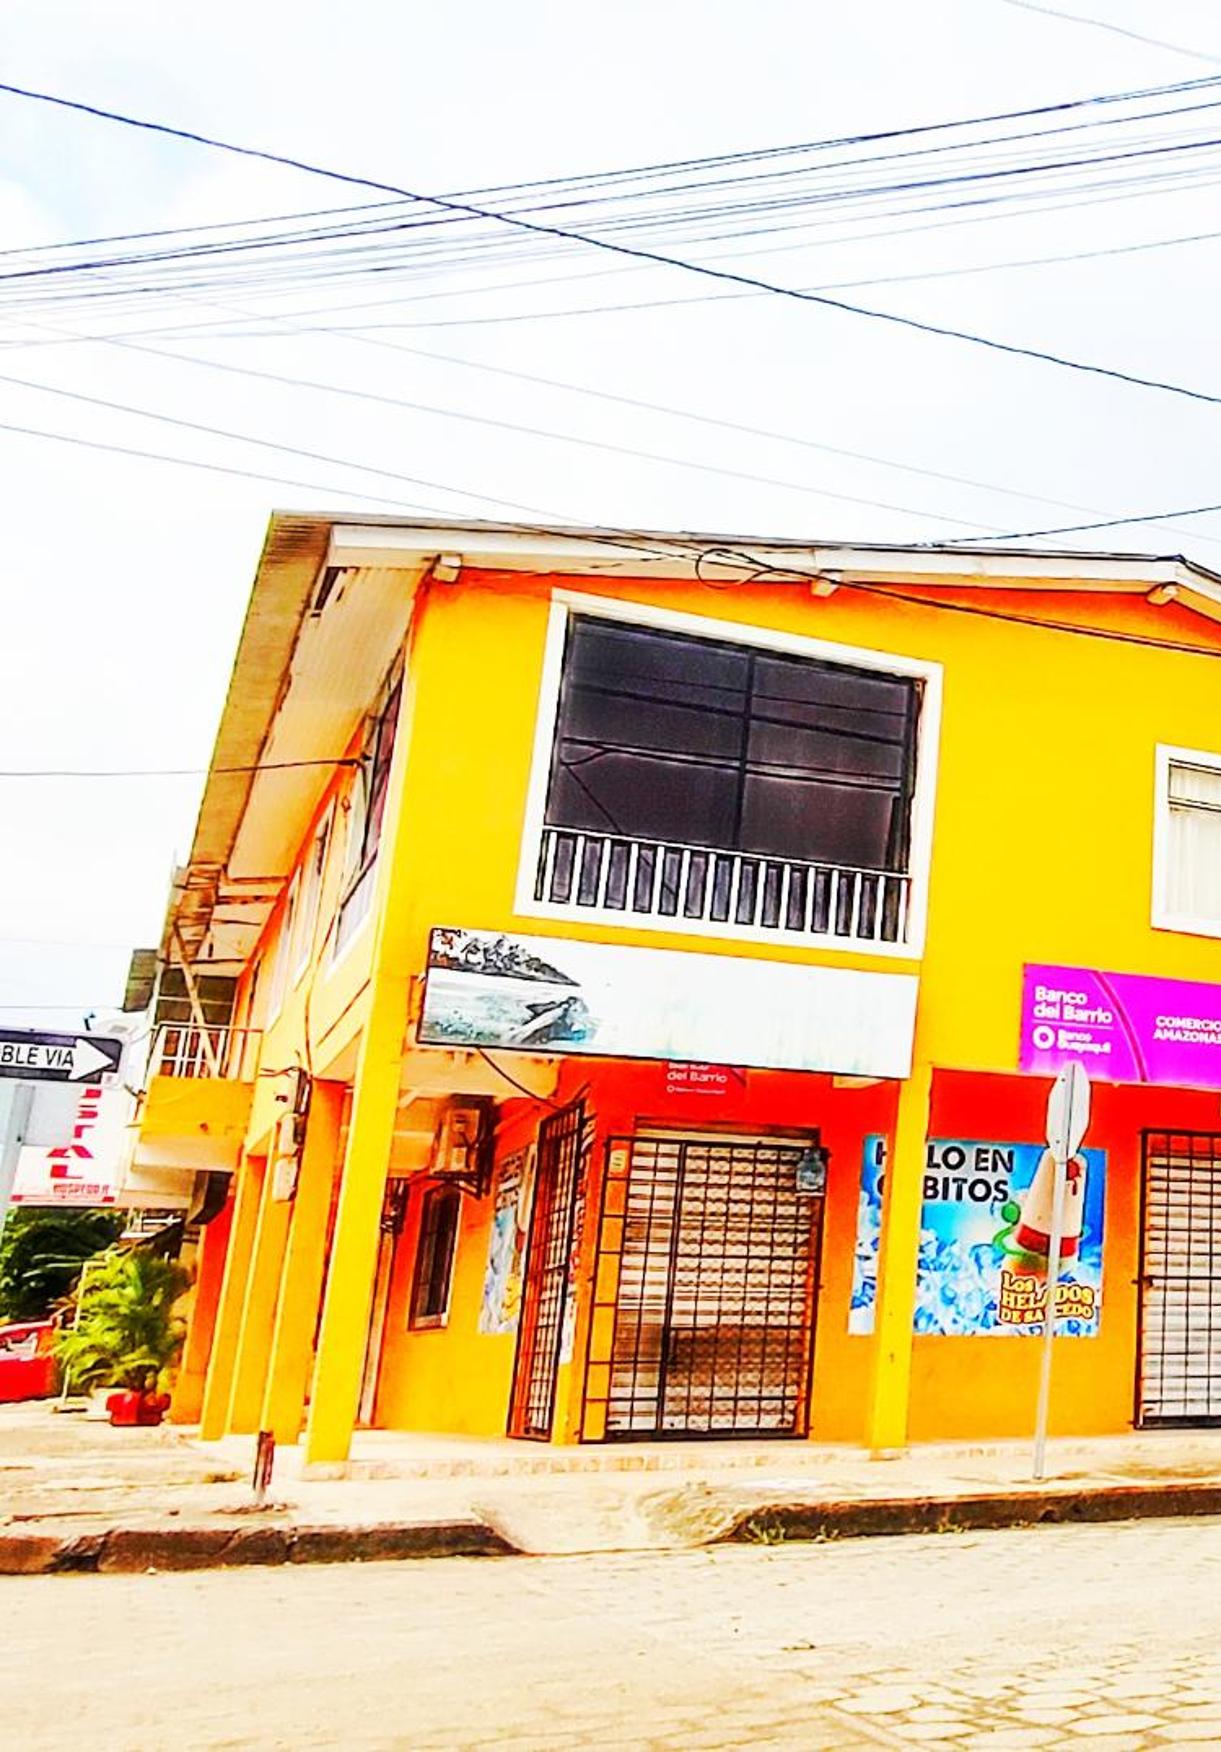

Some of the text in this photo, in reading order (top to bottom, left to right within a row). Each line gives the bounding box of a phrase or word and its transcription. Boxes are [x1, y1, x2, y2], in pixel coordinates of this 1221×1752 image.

[1034, 985, 1088, 1005] Banco
[1033, 1003, 1112, 1024] del Barrio
[45, 1050, 75, 1068] VIA
[667, 1070, 728, 1084] del Barrio
[975, 1148, 1014, 1173] EN
